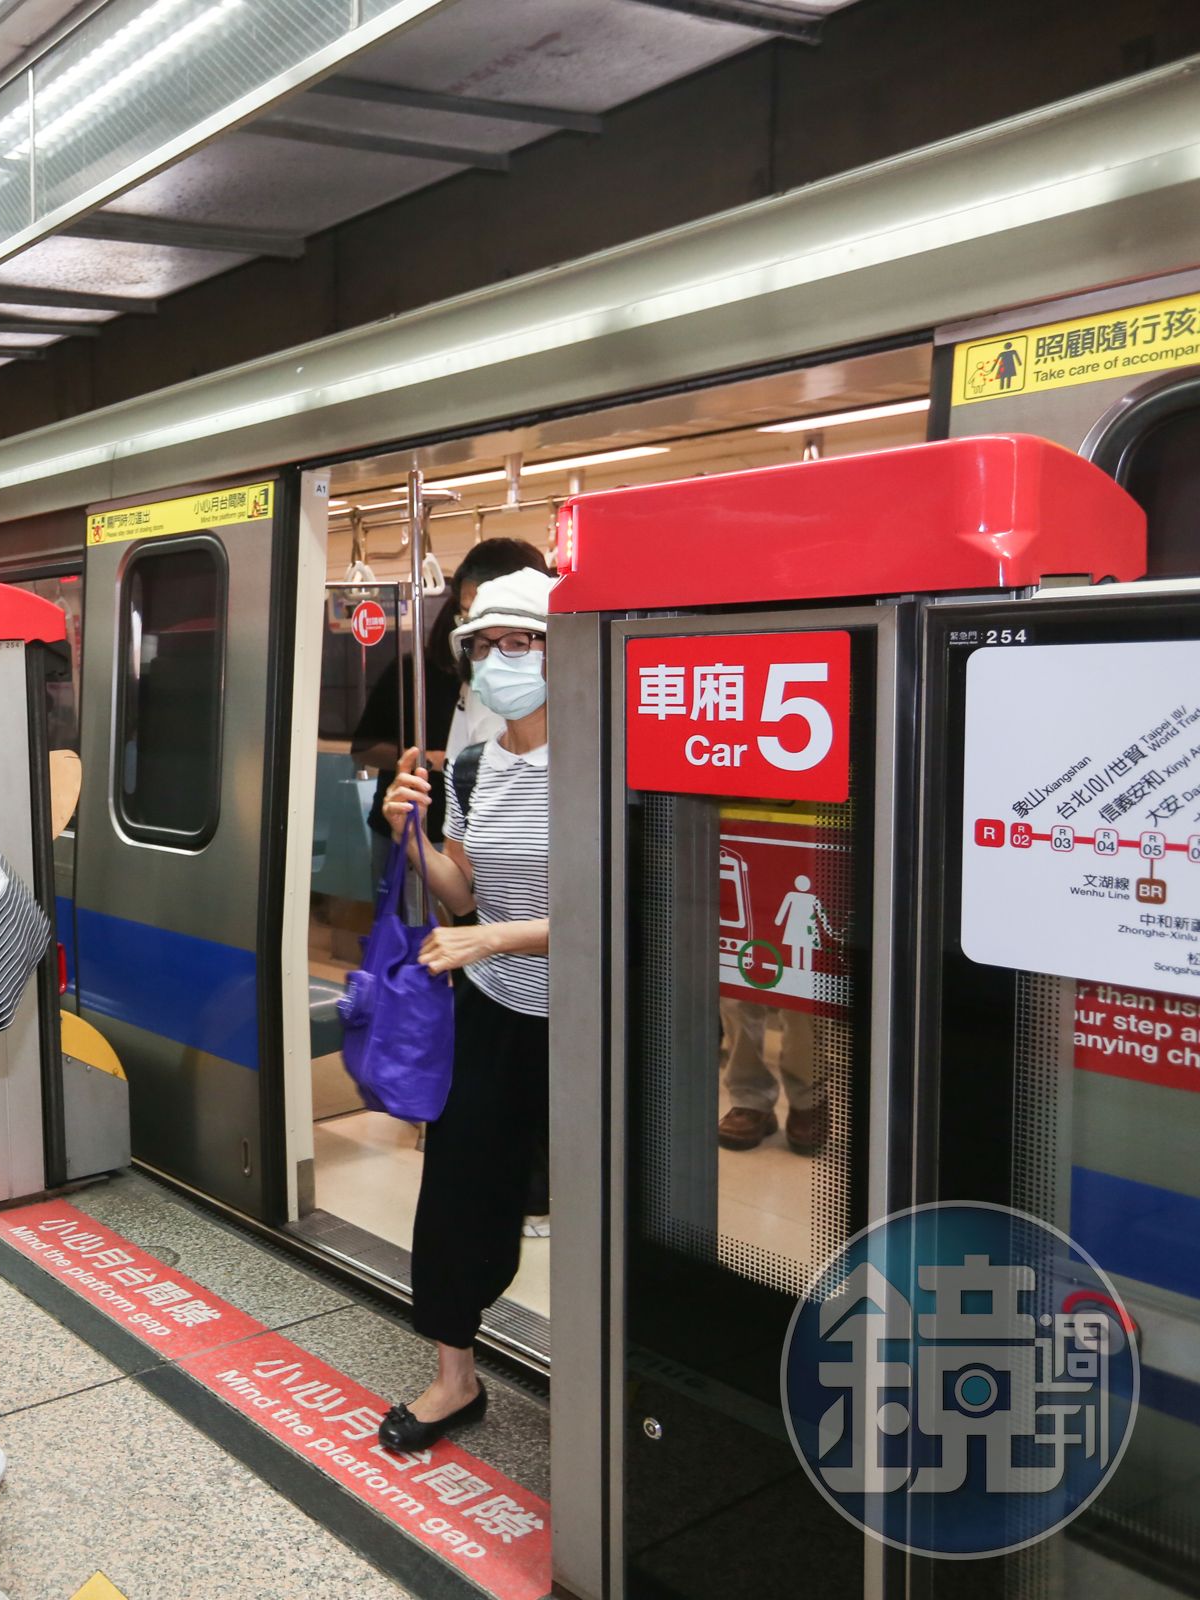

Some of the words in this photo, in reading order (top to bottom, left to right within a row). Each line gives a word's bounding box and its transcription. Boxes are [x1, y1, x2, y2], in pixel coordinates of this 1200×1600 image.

[1035, 307, 1200, 365] 照顧隨行孩
[1033, 368, 1064, 383] Take
[1069, 364, 1099, 378] care
[1104, 356, 1119, 370] of
[316, 484, 326, 493] A1
[986, 629, 1027, 644] 254
[638, 663, 745, 721] 車廂
[756, 662, 833, 772] 5
[1139, 719, 1172, 744] Taipei
[1147, 727, 1180, 752] World
[685, 735, 748, 767] Car
[1012, 788, 1046, 819] 象山
[1042, 756, 1092, 797] Xiangshan
[1098, 769, 1165, 824] 信義安和
[1162, 754, 1191, 777] Xinyi
[1144, 794, 1185, 828] 大安
[983, 827, 995, 840] R
[1012, 834, 1029, 846] 02
[1054, 837, 1071, 849] 03
[1059, 828, 1067, 836] R
[1097, 841, 1115, 852] 04
[1143, 844, 1161, 856] 05
[1070, 886, 1105, 899] Wenhu
[1108, 890, 1130, 900] Line
[1083, 874, 1130, 891] 文湖線
[1139, 885, 1162, 899] BR
[1117, 924, 1198, 942] Zhonghe-Xinlu
[1153, 962, 1200, 976] Songsha
[1096, 986, 1156, 1011] than
[1164, 999, 1200, 1018] us
[1113, 1014, 1173, 1041] step
[1180, 1027, 1200, 1044] a
[8, 1225, 47, 1251] Mind
[43, 1244, 71, 1267] the
[64, 1264, 136, 1313] platform
[128, 1308, 173, 1336] gap
[38, 1218, 222, 1327] 小心月台間隙
[216, 1369, 279, 1409] Mind
[271, 1407, 315, 1437] the
[305, 1437, 426, 1516] platform
[420, 1516, 488, 1558] gap
